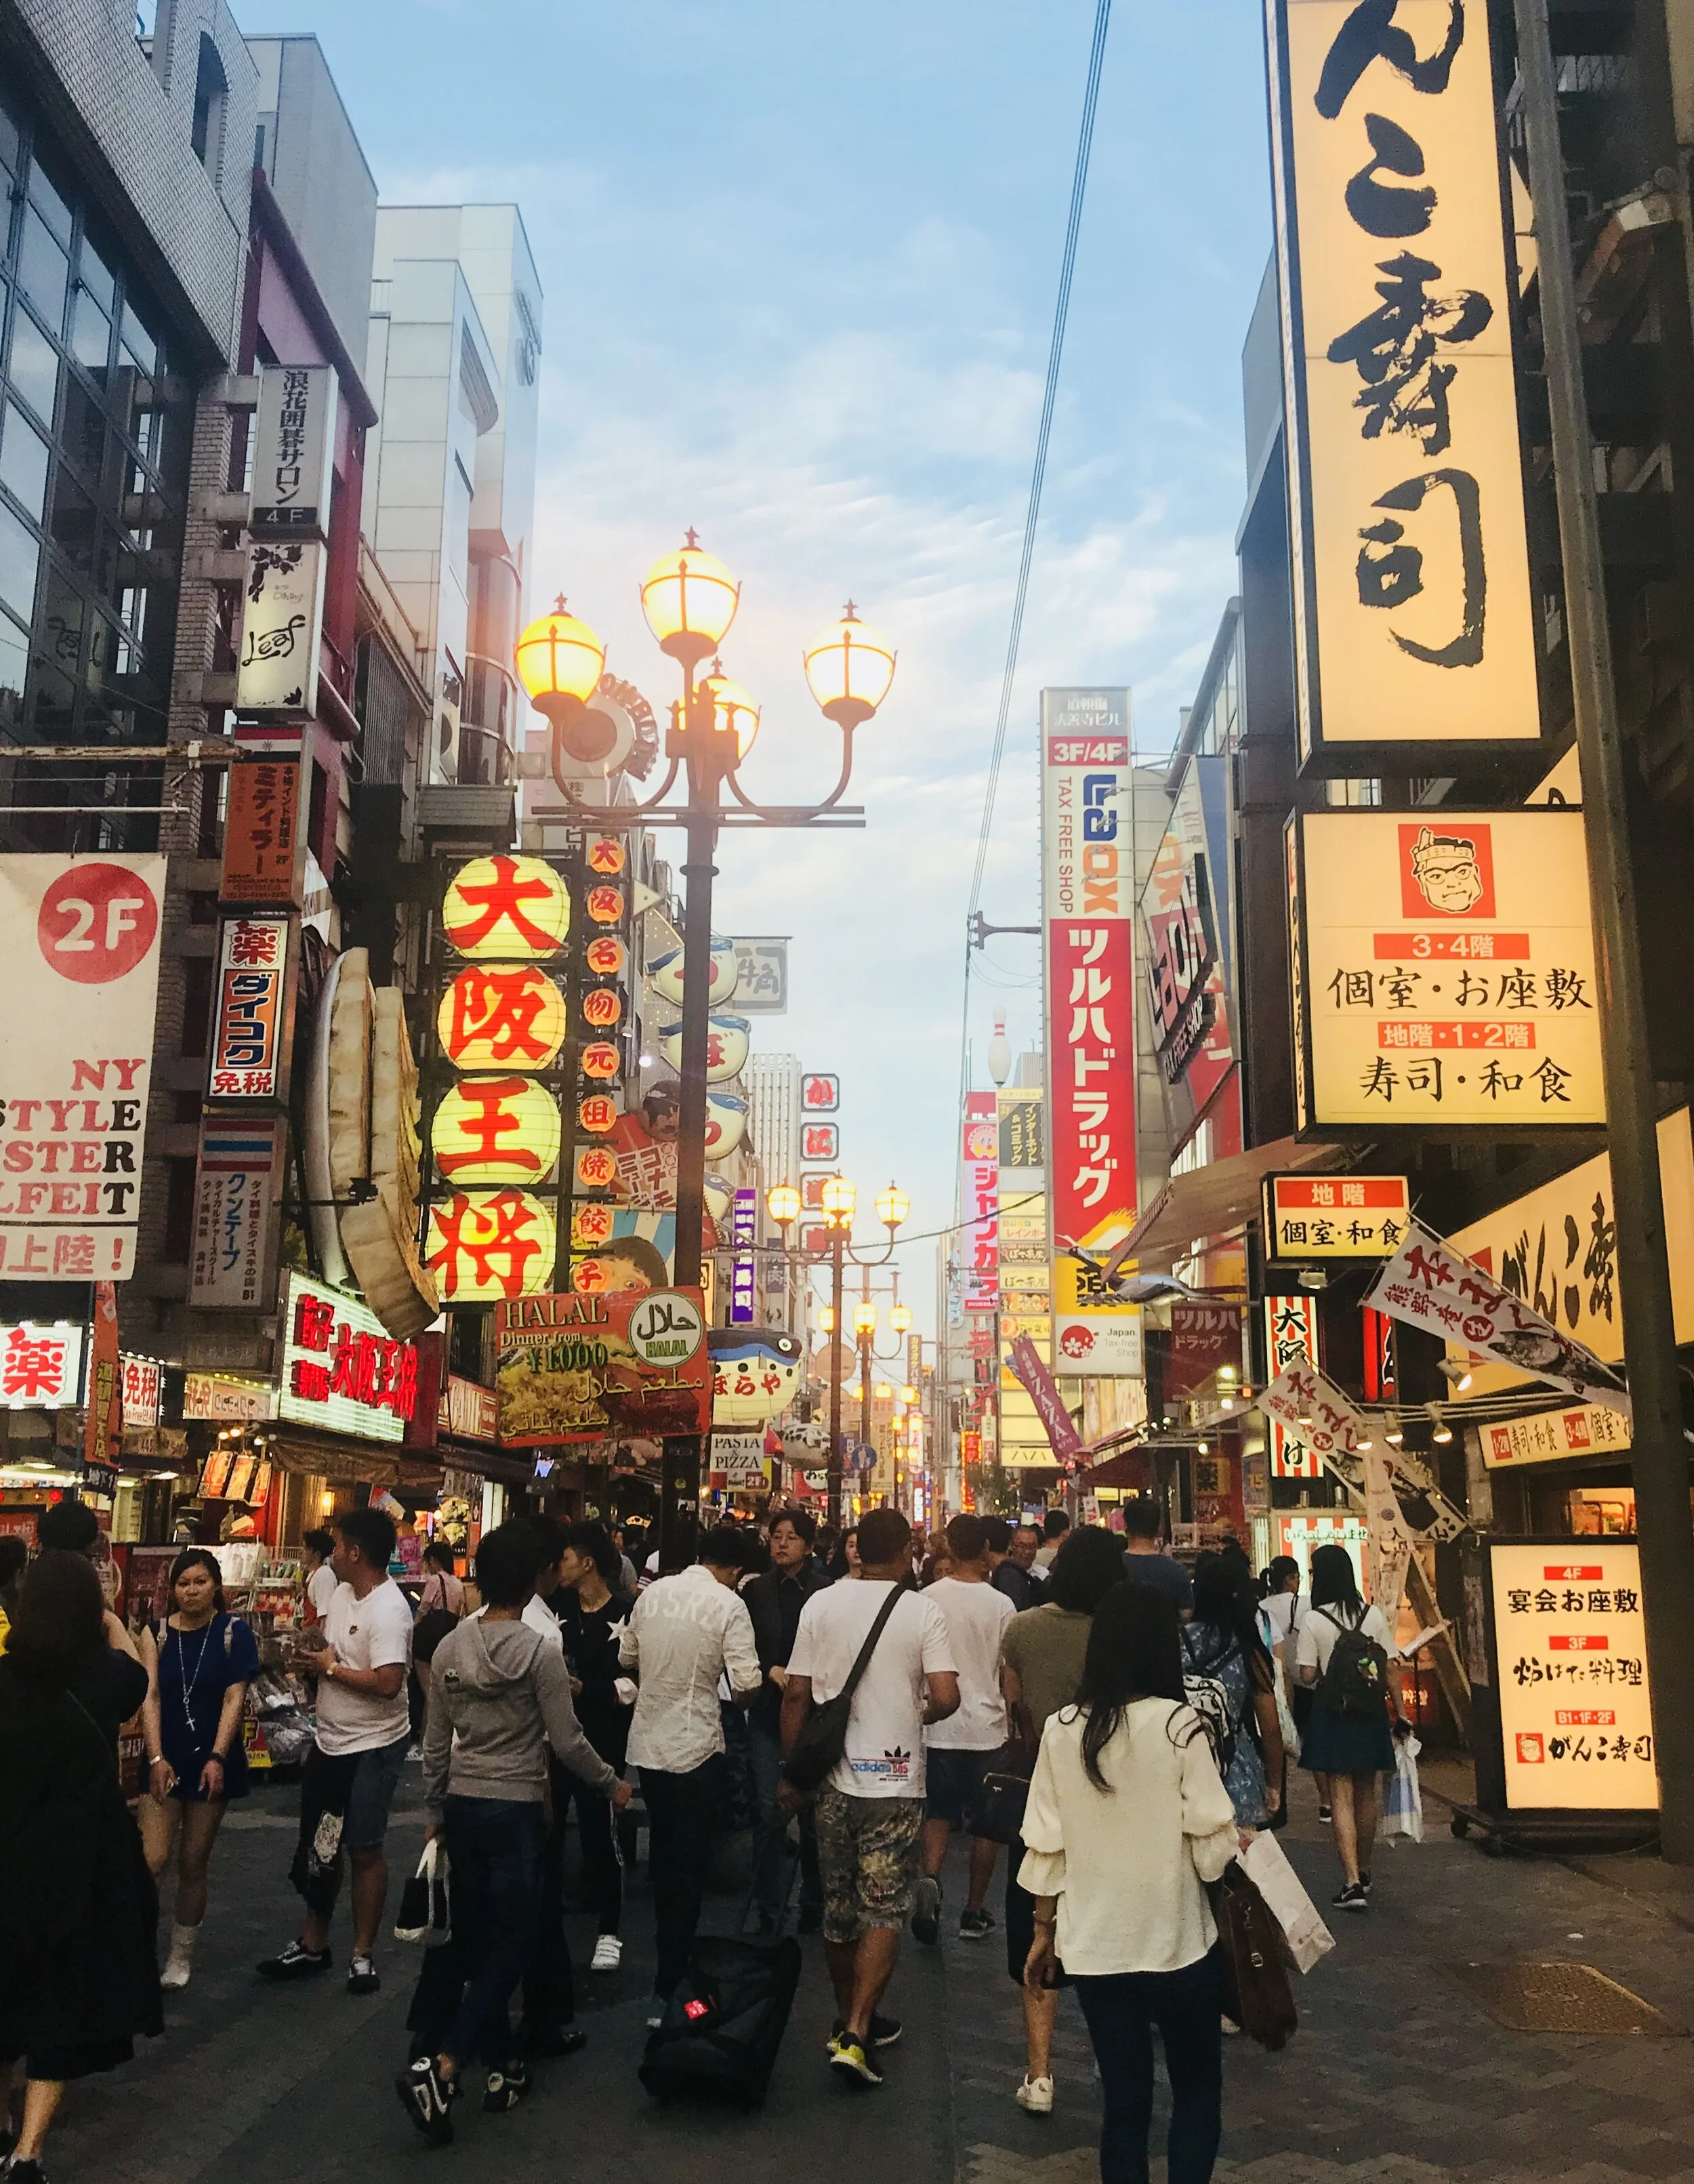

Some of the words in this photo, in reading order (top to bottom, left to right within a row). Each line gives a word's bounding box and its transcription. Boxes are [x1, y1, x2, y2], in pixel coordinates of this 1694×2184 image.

[275, 371, 309, 506] 浪花囲碁サロン
[266, 508, 303, 523] 4F
[241, 615, 306, 667] Leaf
[1054, 743, 1123, 762] 3F/4F
[1058, 777, 1072, 808] TAX
[250, 766, 277, 874] ミティラー
[1058, 815, 1073, 859] FREE
[1059, 865, 1073, 913] SHOP
[55, 898, 144, 951] 2F
[232, 921, 278, 965] 薬
[1327, 967, 1593, 1010] 個室・お座敷
[225, 973, 272, 1066] ダイコク
[1384, 1024, 1529, 1048] 地階・1・2階
[71, 1058, 146, 1091] NY
[426, 856, 564, 1299] 大阪王将
[575, 838, 619, 1290] 大阪名物元祖焼餃子
[1069, 929, 1117, 1208] ツルハドラッグ
[1359, 1056, 1572, 1103] 寿司・和食
[212, 1071, 273, 1095] 免税
[0, 1099, 141, 1132] TYLE
[1010, 1114, 1022, 1166] &コミック
[1025, 1104, 1037, 1166] インターネット
[0, 1141, 137, 1174] STER
[1311, 1183, 1365, 1206] 地階
[1007, 1228, 1045, 1238] レインボー
[1280, 1218, 1404, 1246] 個室・和食
[503, 1297, 609, 1329] HALAL
[636, 1302, 697, 1340] حلال
[1174, 1311, 1239, 1332] ツルハ
[500, 1332, 549, 1347] Dinner
[554, 1332, 582, 1343] from
[646, 1340, 688, 1357] HALAL
[1116, 1349, 1139, 1358] Shop
[1176, 1335, 1227, 1350] ドラッグ
[3, 1327, 65, 1397] 薬
[124, 1362, 158, 1408] 免税
[575, 1370, 632, 1403] حلال
[641, 1367, 705, 1403] مطعم
[715, 1437, 761, 1449] PASTA
[716, 1456, 760, 1469] PIZZA
[1563, 1567, 1582, 1580] 4F
[1508, 1588, 1639, 1613] 宴会お座敷
[1568, 1637, 1587, 1649] 3F
[1513, 1656, 1642, 1687] 炉ばた料理
